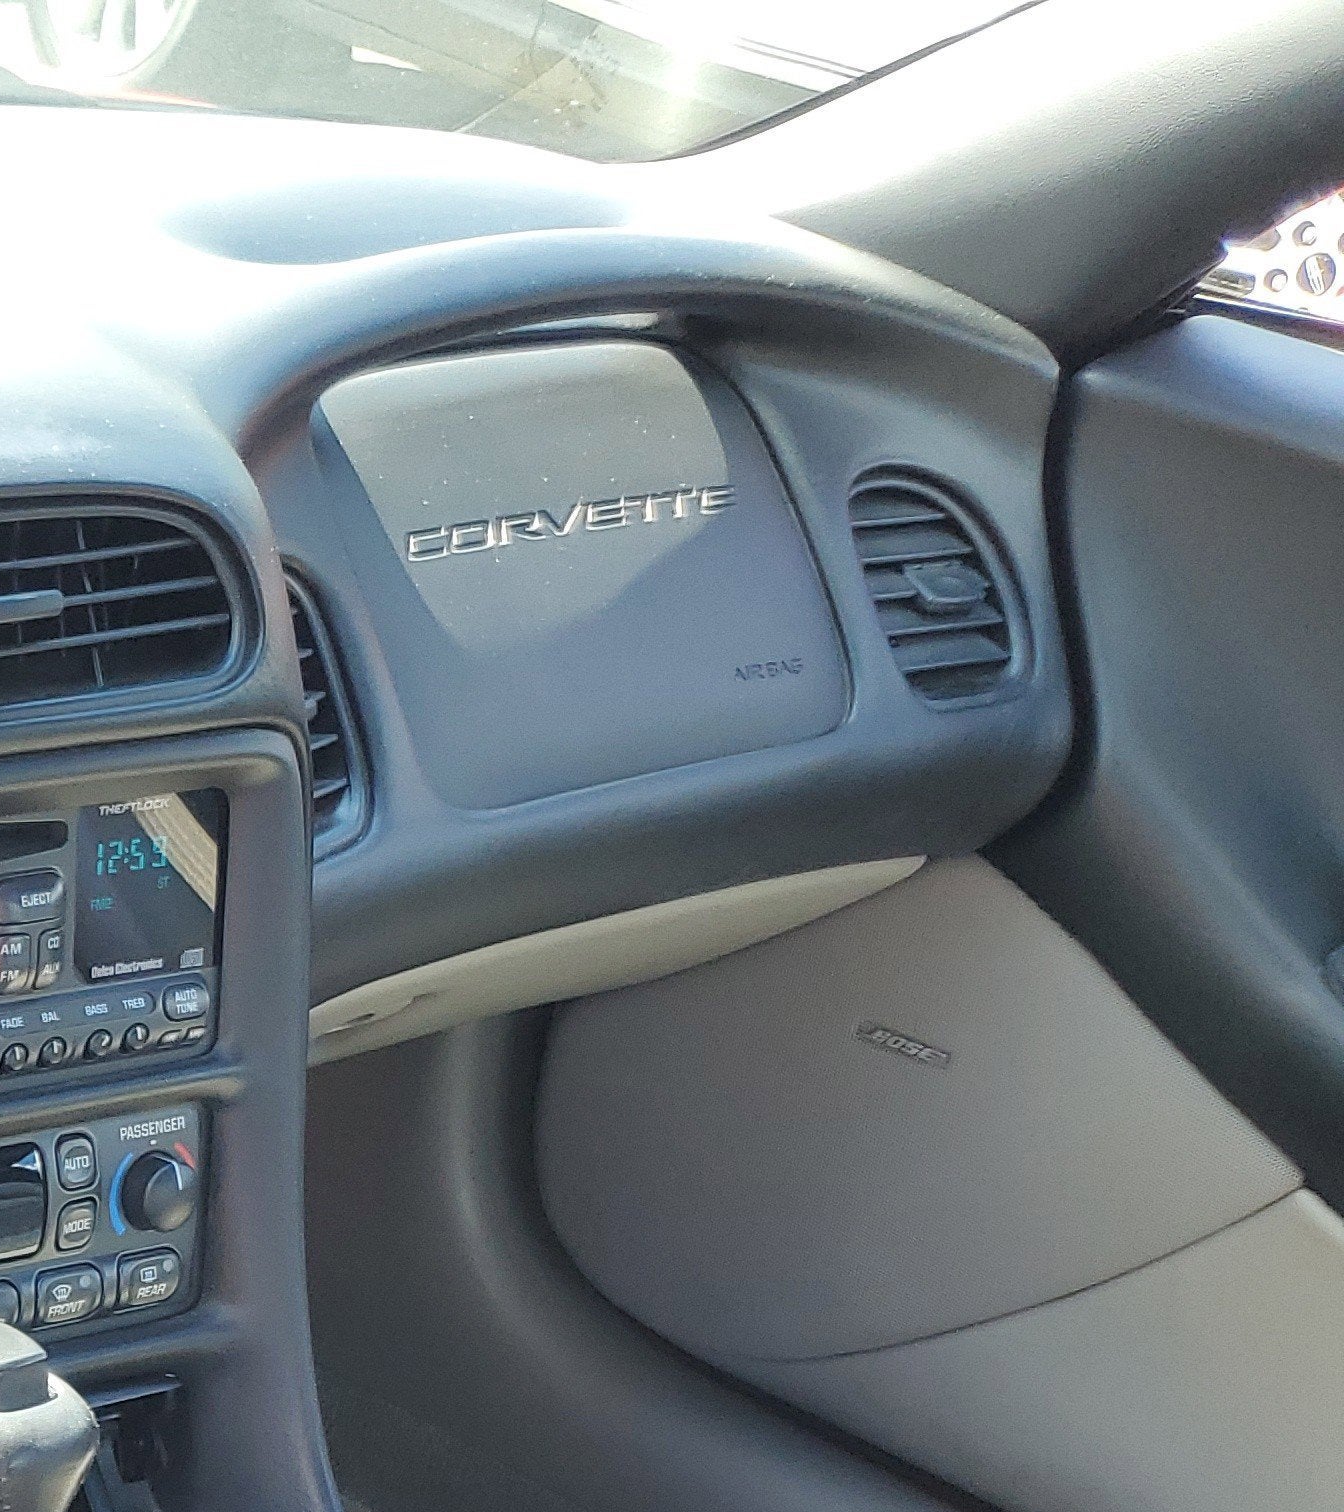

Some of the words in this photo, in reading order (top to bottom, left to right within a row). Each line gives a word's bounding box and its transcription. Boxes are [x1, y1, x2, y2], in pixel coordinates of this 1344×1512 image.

[406, 484, 736, 562] CORVETTE
[98, 798, 170, 816] THEFTLOCK
[97, 836, 168, 876] 12:59
[21, 892, 52, 908] EJECT
[0, 943, 22, 955] AM
[175, 988, 198, 1002] AUTO
[0, 1017, 26, 1029] FADE
[41, 1010, 60, 1023] BAL
[84, 1004, 109, 1016] BASS
[119, 1116, 185, 1141] PASSENGER
[64, 1155, 90, 1171] AUTO
[63, 1218, 91, 1234] MODE
[136, 1283, 167, 1299] REAR
[47, 1300, 85, 1319] FRONT
